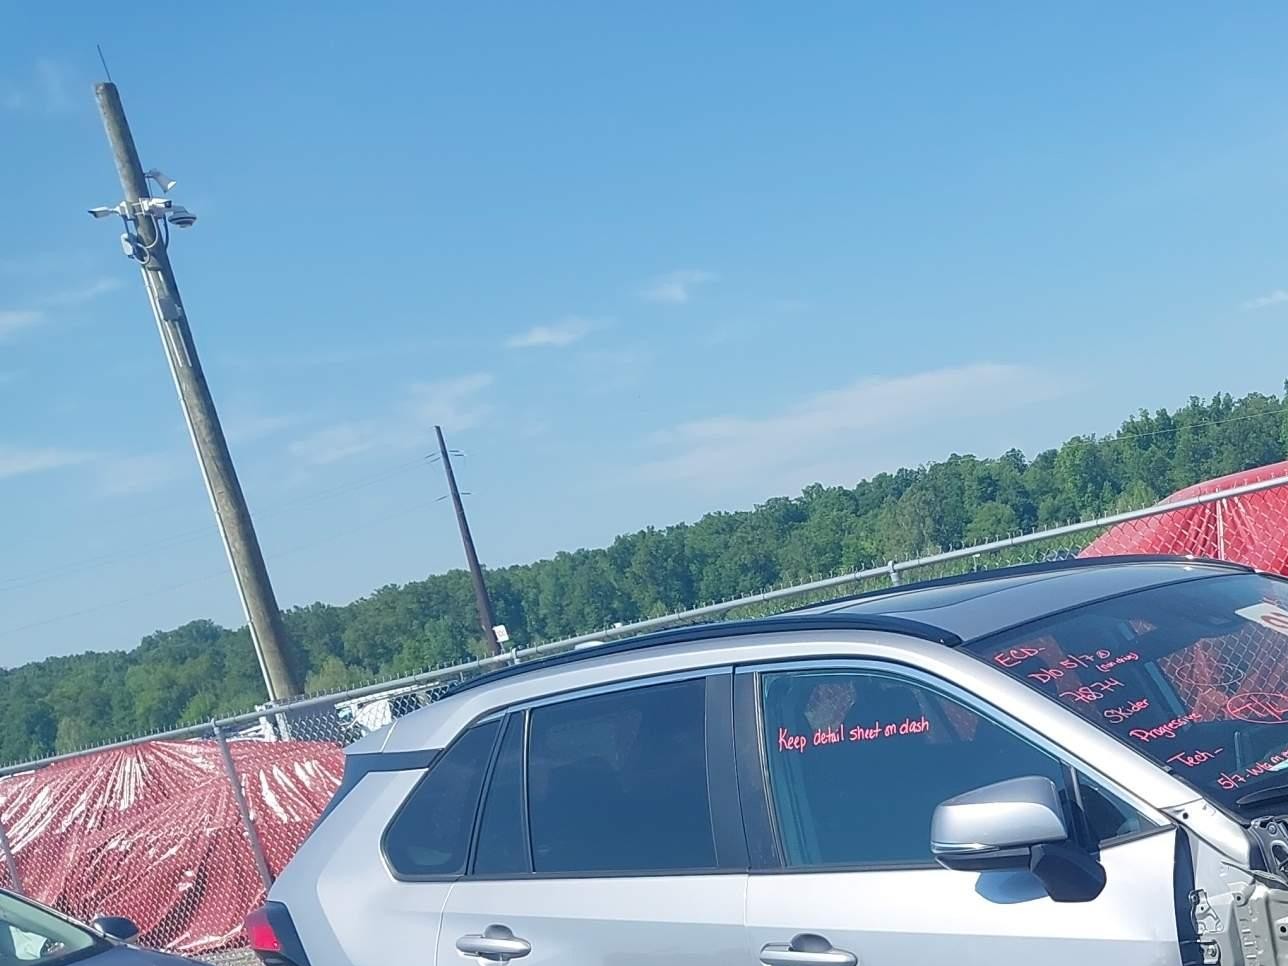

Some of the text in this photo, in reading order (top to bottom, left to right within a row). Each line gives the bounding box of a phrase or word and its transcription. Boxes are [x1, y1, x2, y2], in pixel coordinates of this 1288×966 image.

[1060, 654, 1095, 669] 5/7
[778, 727, 807, 752] Keep
[813, 724, 845, 746] detail
[849, 721, 882, 741] sheet
[899, 716, 930, 735] dash
